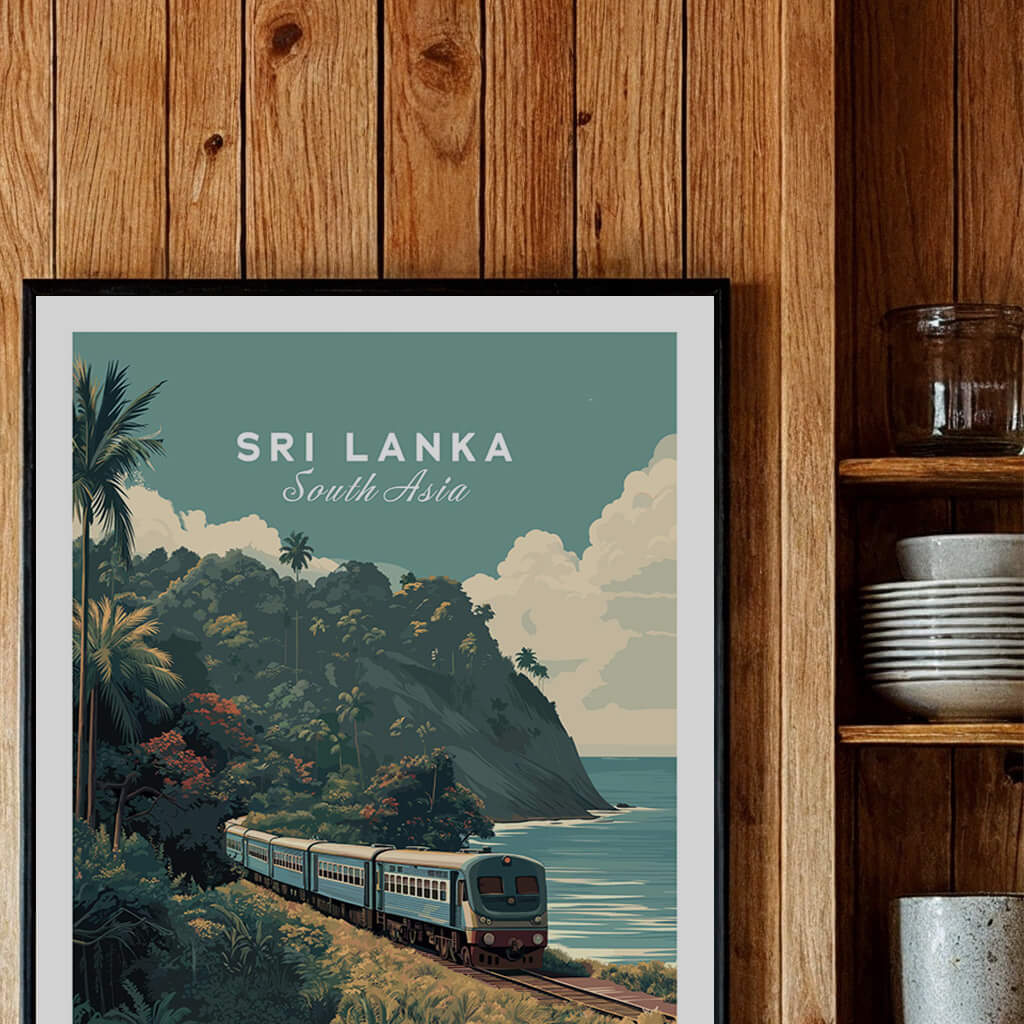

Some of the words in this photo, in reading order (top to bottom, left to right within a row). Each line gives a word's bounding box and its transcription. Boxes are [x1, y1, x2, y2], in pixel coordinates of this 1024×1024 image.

[236, 431, 313, 462] SRI
[346, 432, 513, 462] LANKA
[282, 467, 379, 502] South
[383, 468, 471, 502] Asia
